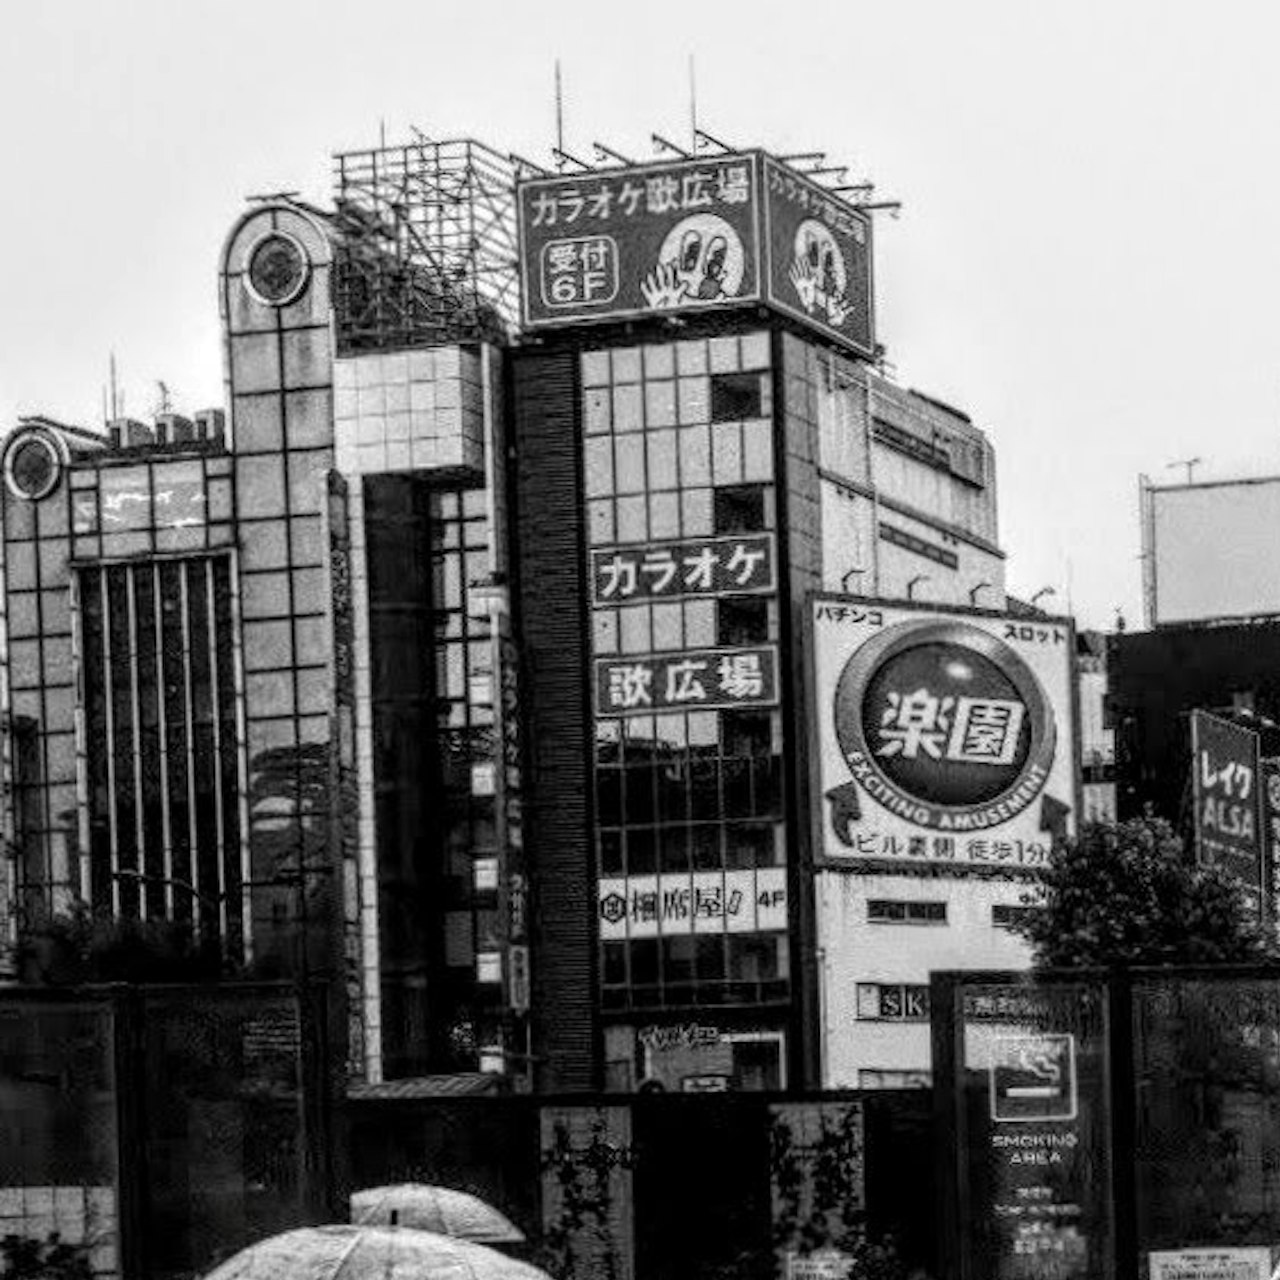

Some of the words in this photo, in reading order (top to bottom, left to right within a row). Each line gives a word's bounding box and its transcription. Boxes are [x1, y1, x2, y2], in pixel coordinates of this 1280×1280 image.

[530, 170, 749, 227] カラオケ歌広場
[549, 241, 608, 274] 受付
[552, 272, 606, 302] 6F
[599, 544, 767, 598] カラオケ
[816, 604, 884, 627] パチンコ
[1005, 623, 1066, 645] スロット
[608, 656, 764, 707] 歌広場
[878, 689, 1026, 766] 楽園
[846, 751, 931, 827] EXCITING
[940, 765, 1047, 829] AMUSEMENT
[1202, 750, 1253, 800] レイク
[1203, 797, 1254, 840] ALSA
[857, 833, 955, 859] ビル裏側
[758, 890, 785, 908] 4F
[991, 1133, 1078, 1148] SMOKING
[1009, 1152, 1062, 1165] AREA
